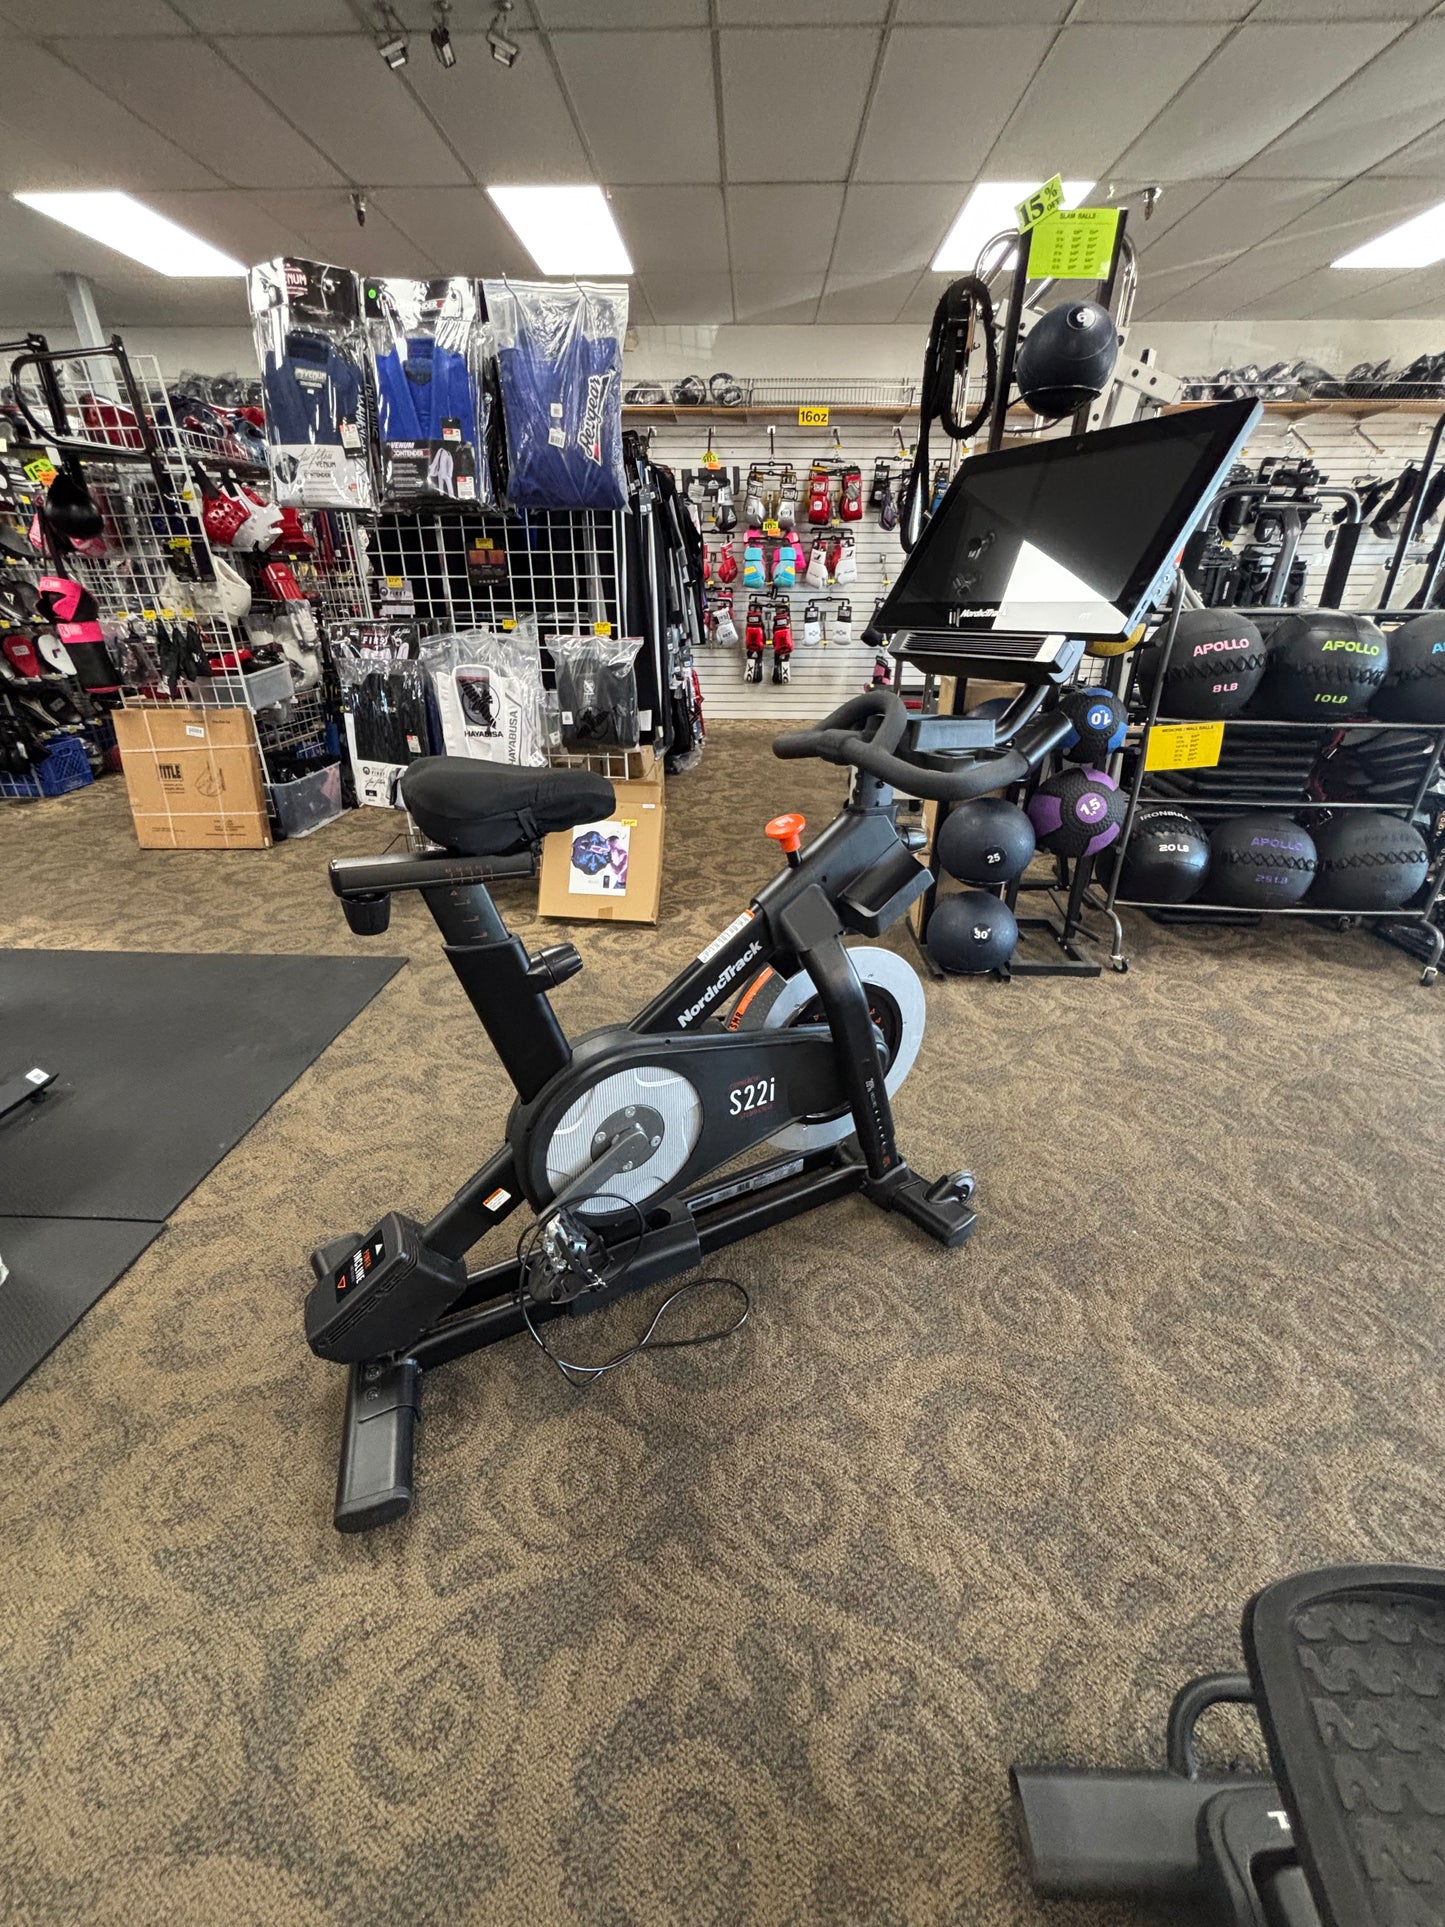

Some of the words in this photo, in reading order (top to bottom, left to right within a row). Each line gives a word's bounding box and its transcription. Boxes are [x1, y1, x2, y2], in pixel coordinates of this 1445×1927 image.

[800, 410, 828, 422] 16oz
[391, 441, 415, 449] VENUM
[315, 460, 336, 468] VENUM
[1193, 637, 1250, 658] APOLLO
[1321, 639, 1381, 656] APOLLO
[1139, 810, 1192, 822] IRONBULL
[1251, 836, 1304, 851] APOLLO
[986, 852, 1001, 864] 25
[677, 939, 763, 1028] NordicTrack
[729, 1076, 775, 1116] S22i
[353, 1248, 366, 1285] INCLINE
